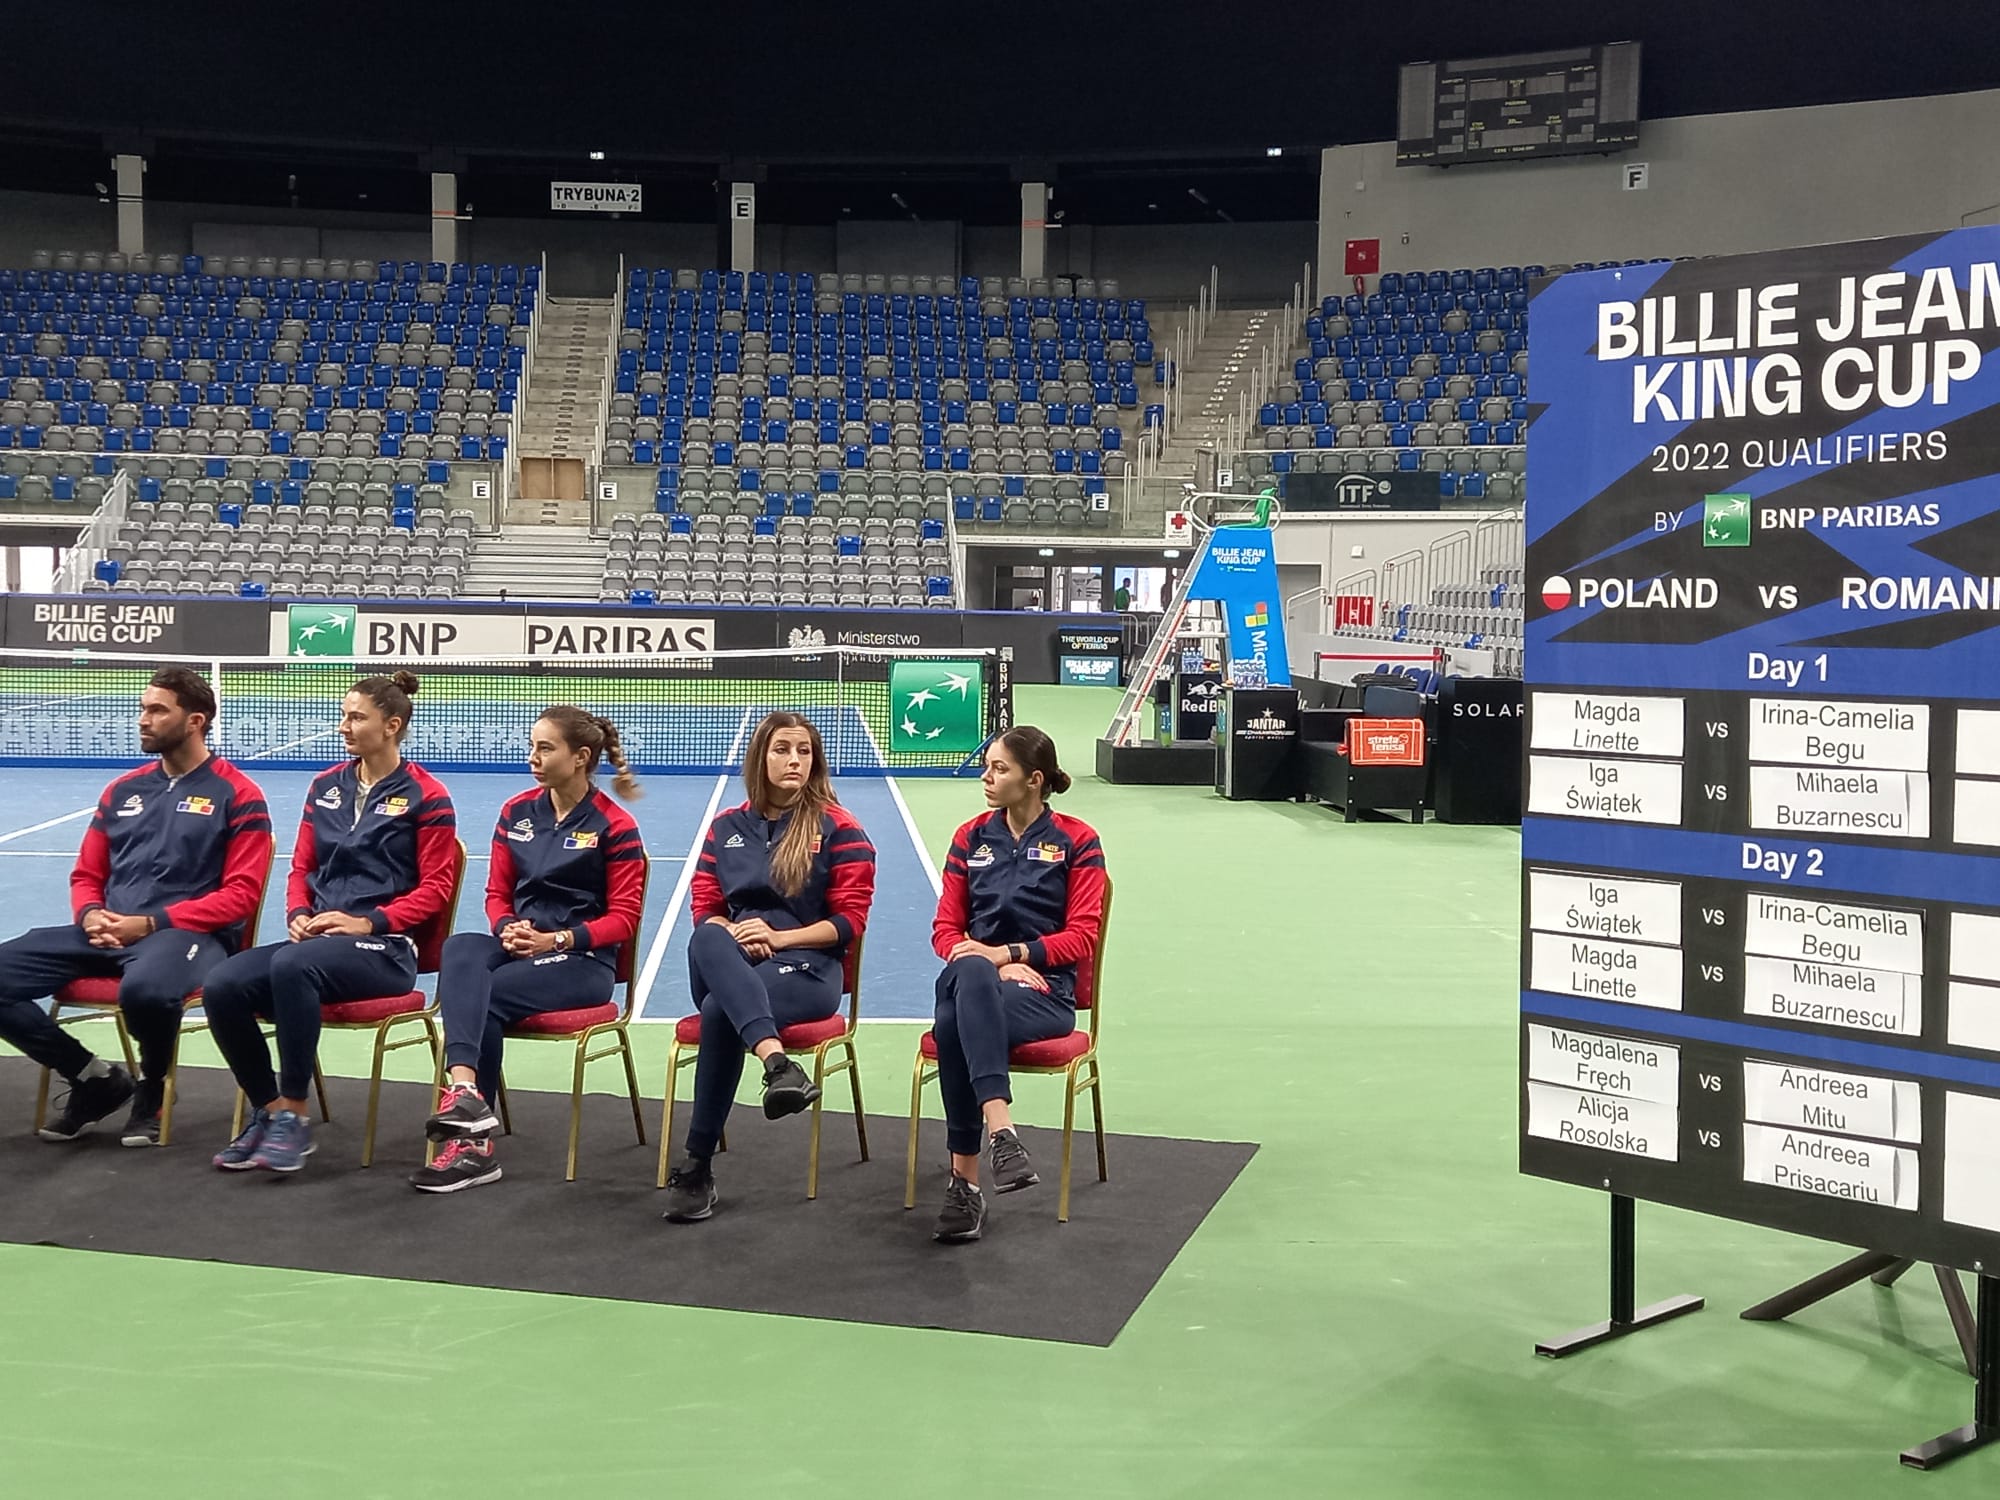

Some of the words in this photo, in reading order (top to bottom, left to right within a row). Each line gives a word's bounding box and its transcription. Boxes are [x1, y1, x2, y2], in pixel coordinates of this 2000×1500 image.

[1629, 171, 1642, 188] F
[553, 187, 640, 202] TRYBUNA-2
[737, 203, 749, 217] E
[1597, 282, 1799, 361] BILLIE
[1632, 352, 1802, 423] KING
[1821, 338, 1982, 411] CUP
[1651, 442, 1731, 472] 2022
[1741, 430, 1948, 469] QUALIFIERS
[477, 485, 486, 497] E
[604, 487, 613, 498] E
[1220, 474, 1229, 485] F
[1095, 499, 1104, 509] E
[1339, 485, 1374, 503] ITF
[1654, 510, 1684, 532] BY
[1760, 507, 1816, 529] BNP
[1822, 502, 1941, 528] PARIBAS
[1212, 547, 1239, 556] BILLIE
[1240, 548, 1266, 557] JEAN
[1241, 556, 1261, 564] CUP
[1579, 576, 1719, 609] POLAND
[1758, 585, 1799, 609] vs
[34, 604, 106, 623] BILLIE
[110, 605, 175, 625] JEAN
[46, 623, 107, 642] KING
[112, 625, 163, 643] CUP
[368, 621, 458, 656] BNP
[527, 624, 707, 655] PARIBAS
[838, 630, 921, 646] Ministerstwo
[1000, 662, 1008, 693] BNP
[1747, 652, 1805, 687] Day
[1814, 654, 1829, 681] 1
[1000, 698, 1008, 731] PAR
[1181, 699, 1208, 712] Red
[1574, 700, 1641, 727] Magda
[1762, 702, 1915, 732] Irina-Camelia
[1246, 718, 1286, 730] JANTAR
[1705, 721, 1729, 739] vs
[1572, 729, 1640, 752] Linette
[1806, 736, 1865, 765] Begu
[1589, 762, 1619, 787] Iga
[1796, 771, 1879, 795] Mihaela
[1566, 785, 1642, 817] Świątek
[1704, 783, 1728, 802] vs
[1776, 805, 1903, 830] Buzarnescu
[1742, 842, 1798, 881] Day
[1806, 848, 1825, 877] 2
[1589, 881, 1619, 907] Iga
[1566, 904, 1643, 938] Świątek
[1701, 907, 1726, 927] vs
[1759, 898, 1909, 937] Irina-Camelia
[1571, 943, 1638, 971] Magda
[1571, 972, 1637, 998] Linette
[1700, 964, 1724, 982] vs
[1793, 963, 1876, 993] Mihaela
[1771, 994, 1897, 1031] Buzarnescu
[1551, 1030, 1659, 1068] Magdalena
[1577, 1063, 1632, 1092] Fręch
[1699, 1072, 1722, 1092] vs
[1780, 1068, 1869, 1099] Andreea
[1577, 1095, 1629, 1123] Alicja
[1802, 1104, 1846, 1130] Mitu
[1559, 1120, 1648, 1154] Rosolska
[1698, 1128, 1721, 1148] vs
[1781, 1133, 1871, 1168] Andreea
[1774, 1164, 1879, 1203] Prisacariu
